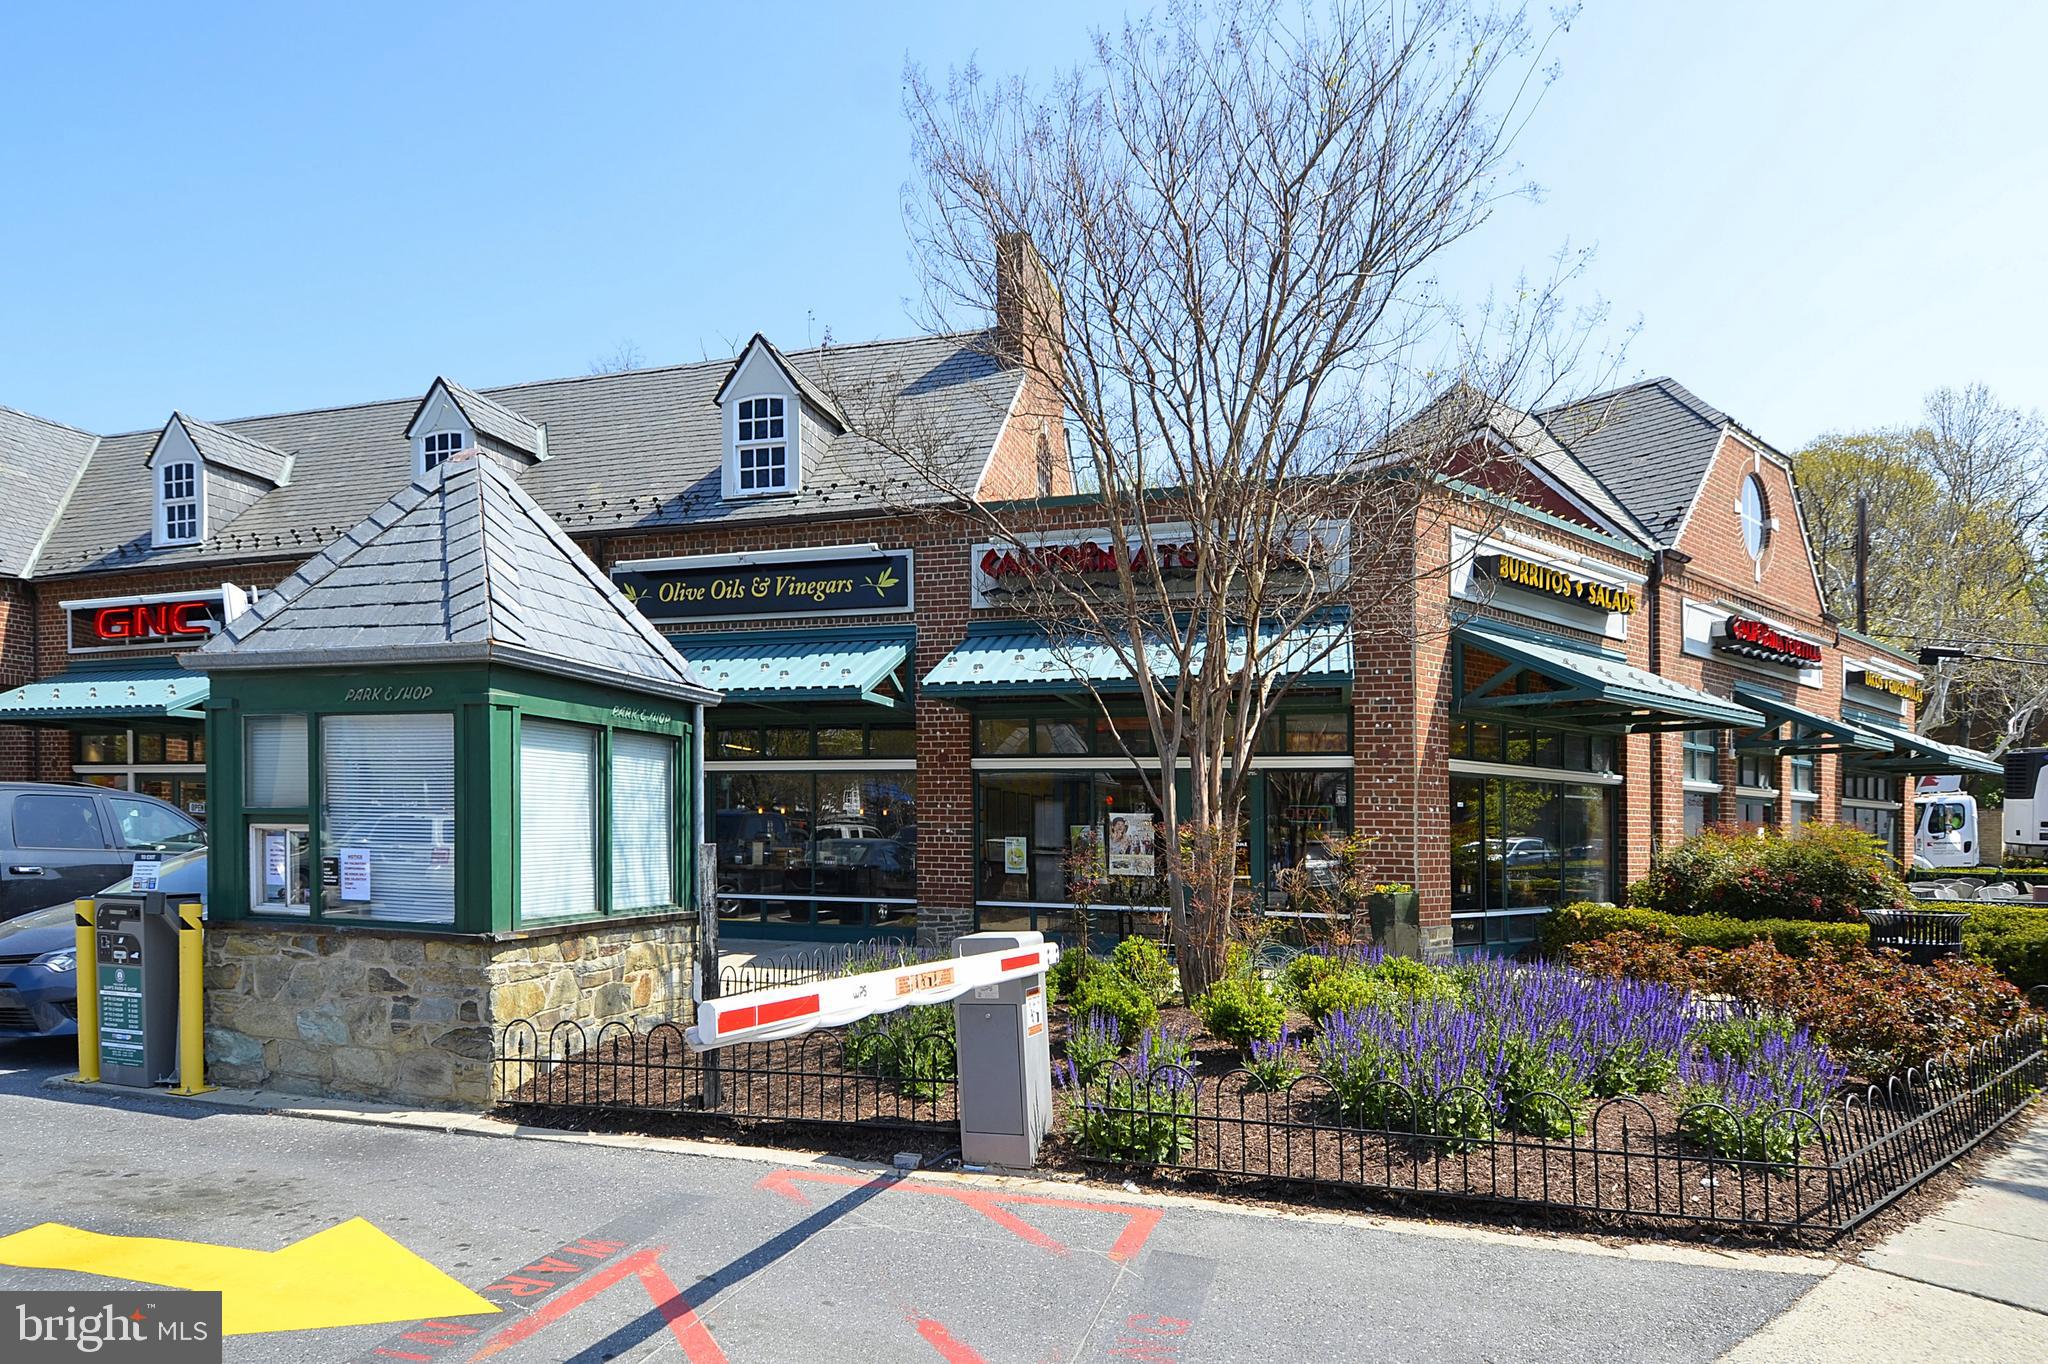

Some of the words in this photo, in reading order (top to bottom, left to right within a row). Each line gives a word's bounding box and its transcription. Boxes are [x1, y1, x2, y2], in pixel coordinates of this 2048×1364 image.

[980, 541, 1155, 580] CALIFORNA
[658, 582, 706, 602] Olive
[710, 578, 745, 600] Oils
[751, 576, 771, 597] &
[775, 576, 854, 602] Vinegars
[1498, 554, 1571, 597] BURRITOS
[1588, 581, 1636, 615] SALADS
[94, 601, 211, 639] GNC
[345, 687, 383, 701] PARK
[384, 686, 393, 701] &
[394, 686, 433, 700] SHOP
[611, 705, 639, 720] PARK
[647, 711, 671, 724] SHOP
[1285, 806, 1329, 820] OPEN
